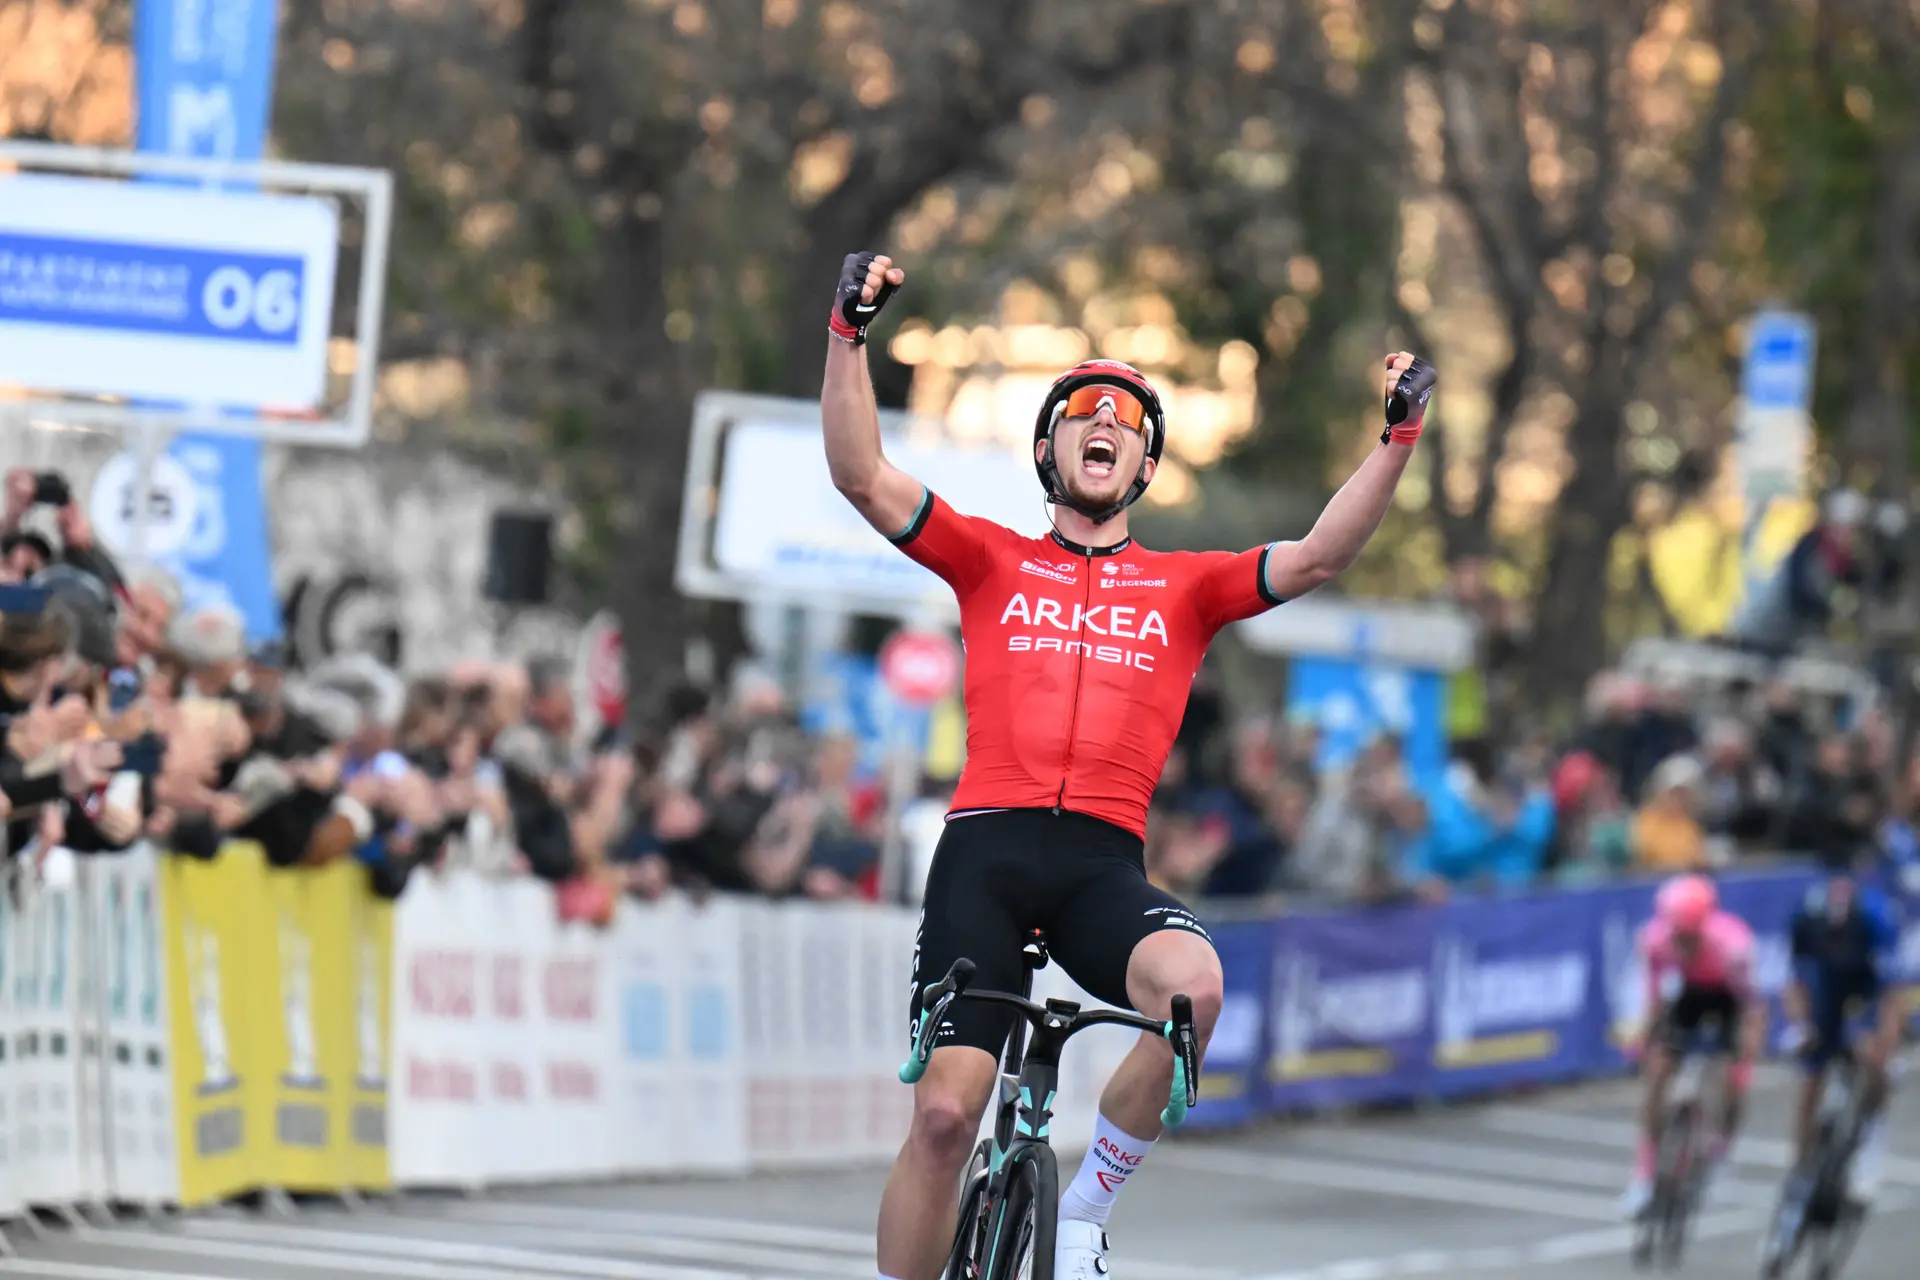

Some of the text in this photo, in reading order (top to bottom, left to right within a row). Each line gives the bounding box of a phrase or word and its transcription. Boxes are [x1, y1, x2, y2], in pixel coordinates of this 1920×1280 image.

[202, 264, 297, 334] 06
[1117, 579, 1167, 588] LEGENDRE
[1000, 592, 1168, 647] ARKEA
[1008, 636, 1155, 672] SAMSIC
